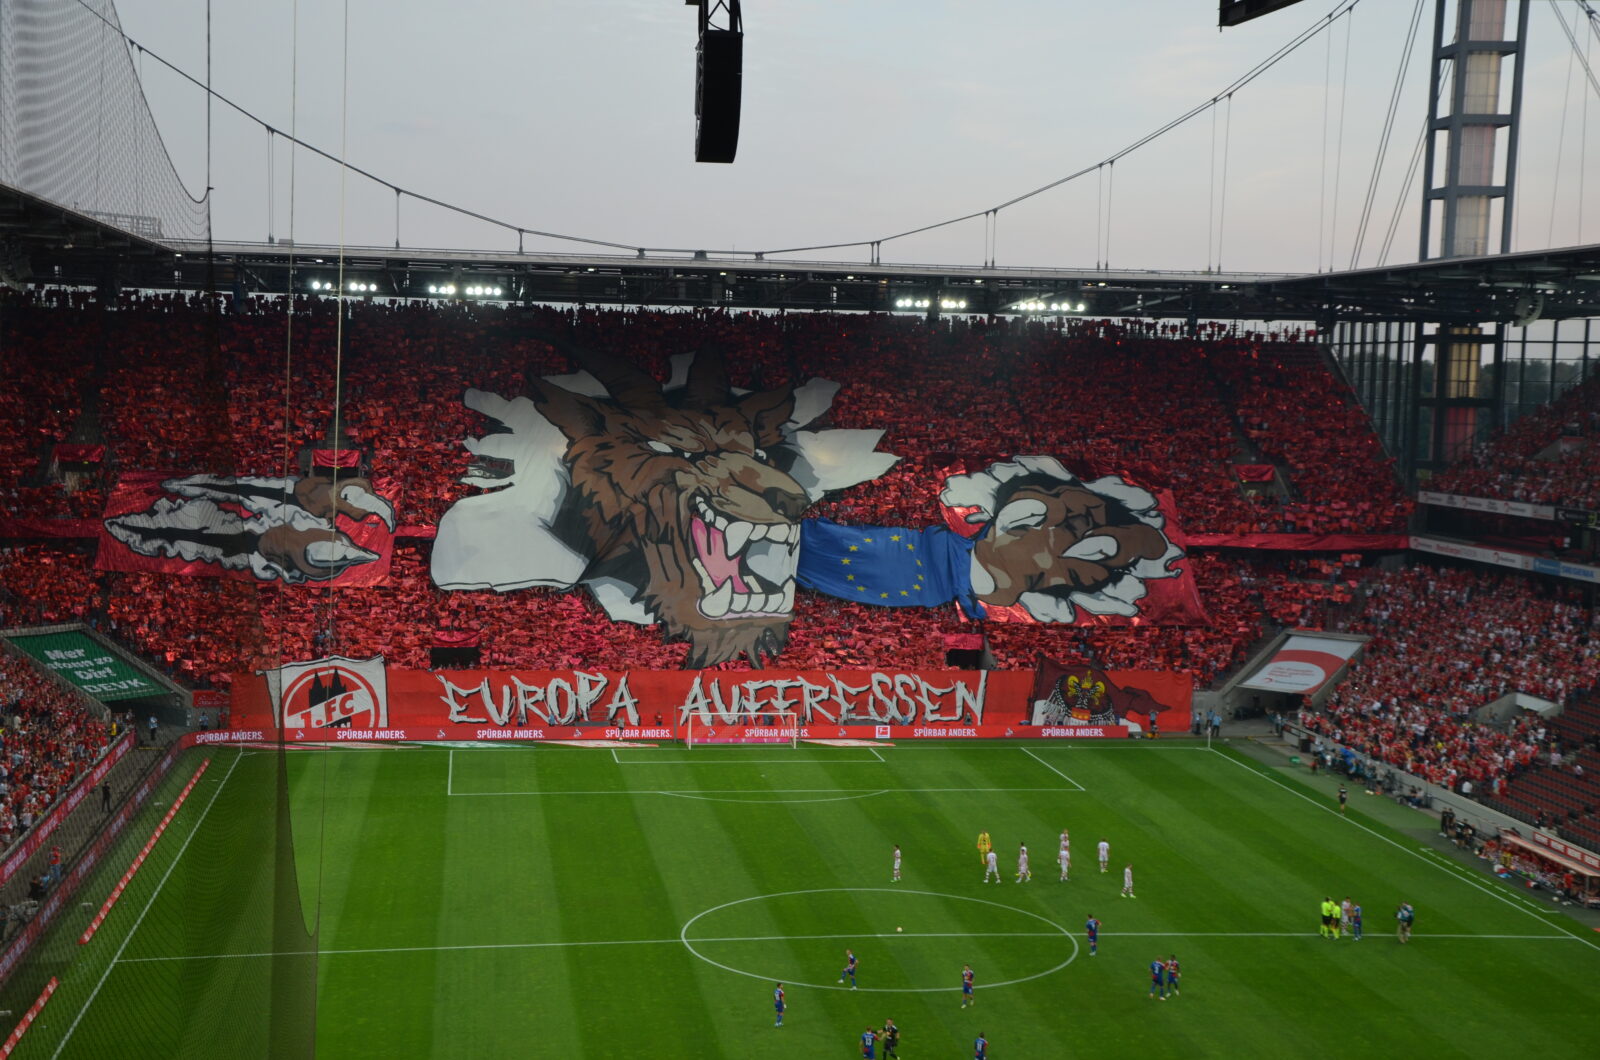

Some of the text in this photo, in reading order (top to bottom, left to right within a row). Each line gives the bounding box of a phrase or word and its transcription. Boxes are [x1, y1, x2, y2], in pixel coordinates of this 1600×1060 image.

[44, 649, 85, 660] Mer
[82, 679, 149, 693] DEVK
[435, 669, 987, 727] EUROPA AUFFRESSEN
[196, 731, 265, 744] SPÜRBAR ANDERS.
[336, 729, 407, 740] SPÜRBAR ANDERS.
[476, 728, 545, 739] SPÜRBAR ANDERS.
[642, 729, 672, 739] ANDERS.
[745, 727, 811, 738] SPÜRBAR ANDERS.
[913, 727, 978, 737] SPÜRBAR ANDERS.
[1042, 727, 1105, 737] SPÜRBAR ANDERS.
